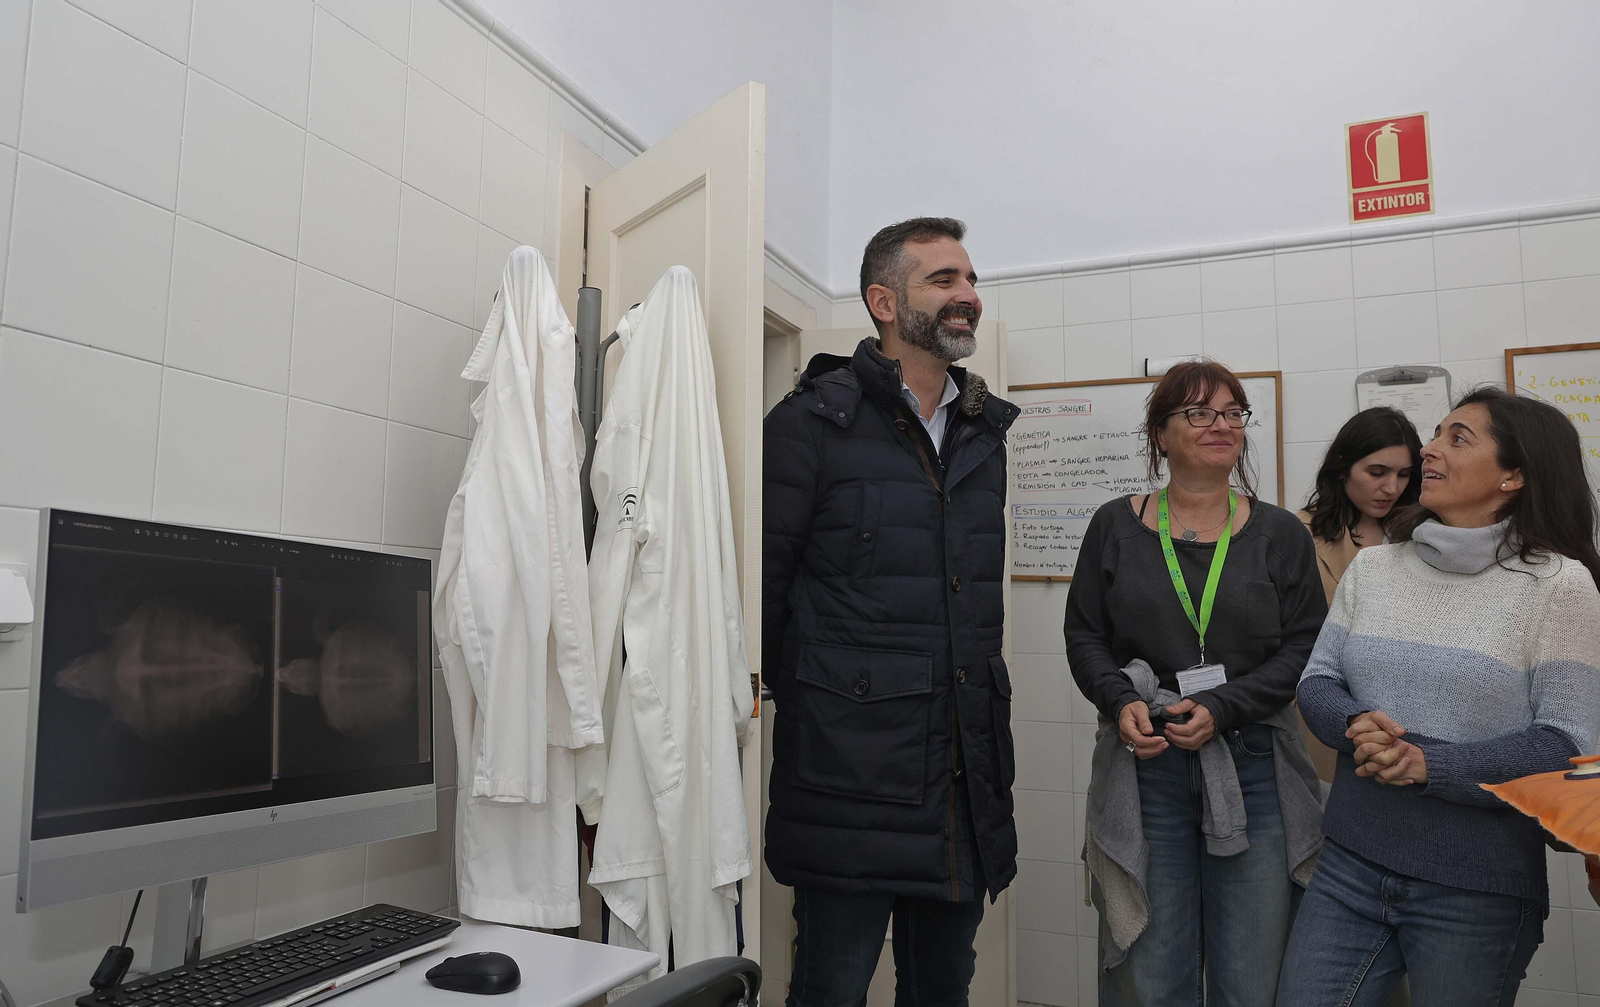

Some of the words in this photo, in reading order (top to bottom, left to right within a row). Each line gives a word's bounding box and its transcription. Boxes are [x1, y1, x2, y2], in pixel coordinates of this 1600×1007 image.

[1358, 192, 1425, 212] EXTINTOR
[1020, 406, 1051, 416] UESTRAS
[1058, 404, 1087, 414] SANGRE
[1061, 434, 1088, 443] SANGRE
[1099, 431, 1130, 440] ETANOL
[1017, 459, 1046, 468] PLASMA
[1060, 456, 1091, 466] SANGRE
[1095, 454, 1129, 462] HEPARINA
[1017, 472, 1039, 480] EDTA
[1054, 469, 1108, 477] CONGELADOR
[1113, 486, 1142, 494] PLASMA
[1015, 506, 1057, 517] ESTUDIO
[1066, 506, 1098, 518] ALGAS
[1040, 524, 1064, 533] tortuga
[1023, 533, 1049, 541] Raspado
[1023, 543, 1047, 553] Recoger
